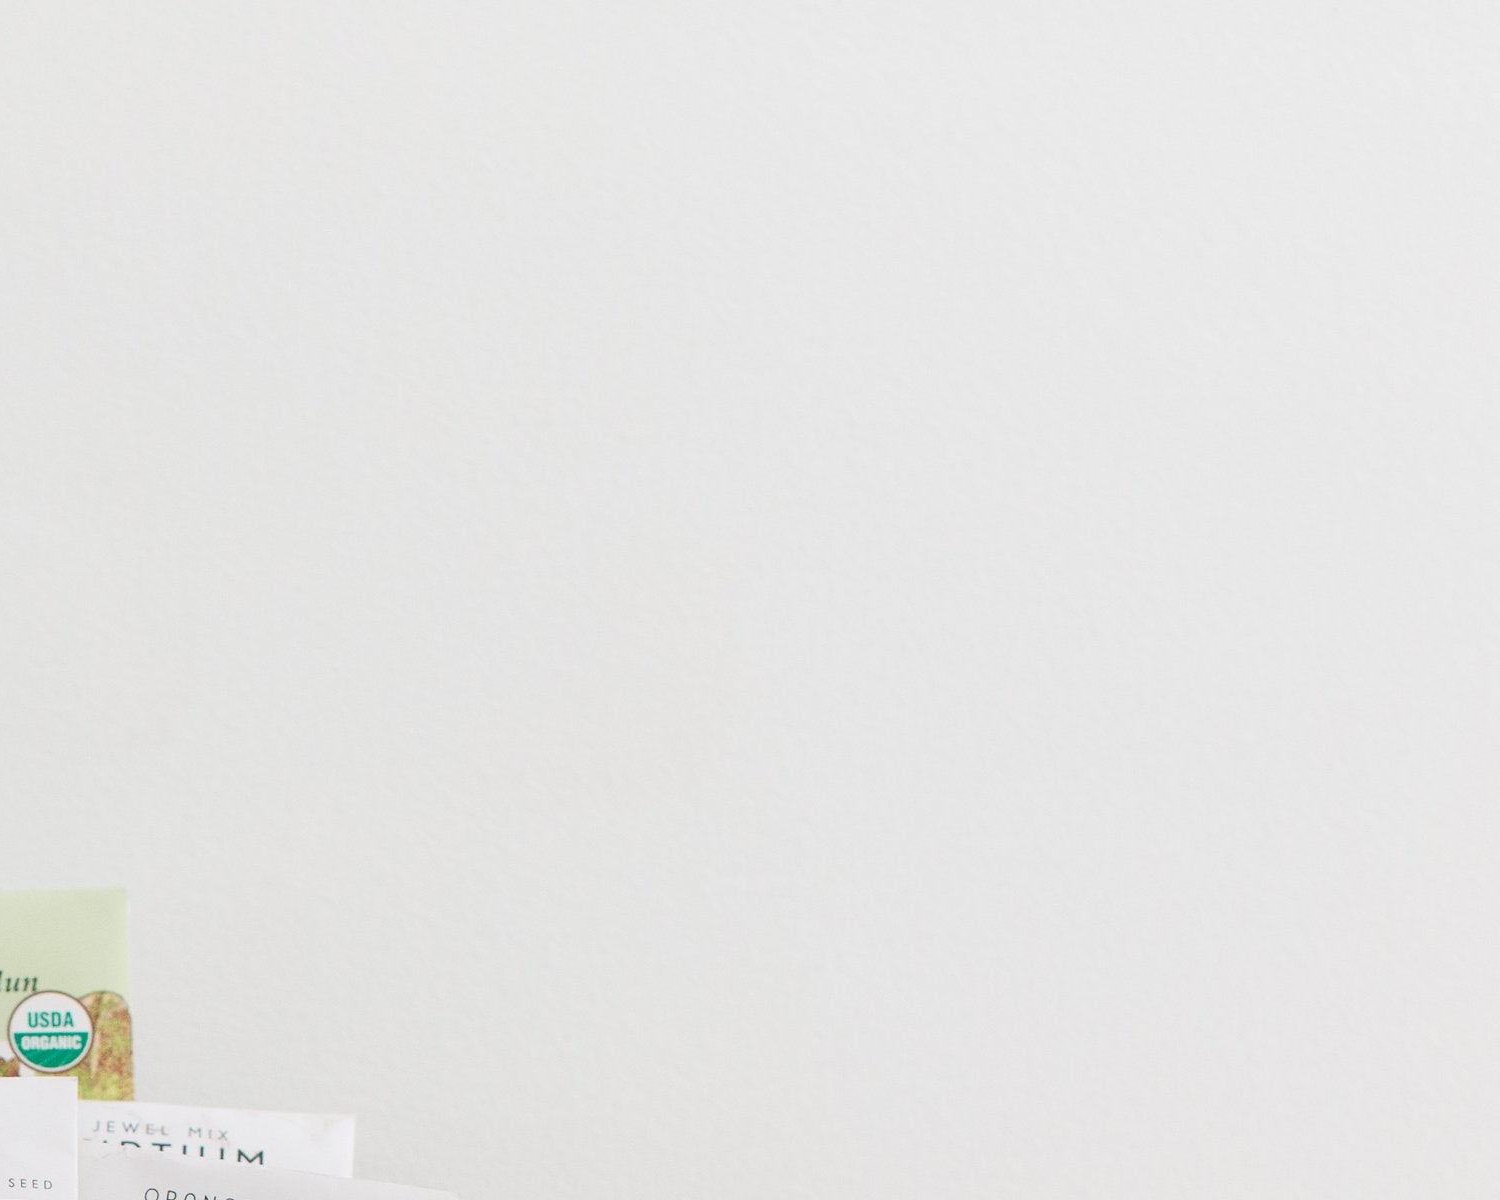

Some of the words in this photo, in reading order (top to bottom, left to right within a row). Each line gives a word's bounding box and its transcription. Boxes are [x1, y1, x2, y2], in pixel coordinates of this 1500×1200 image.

[28, 1011, 74, 1028] USDA
[21, 1034, 83, 1051] ORGANIC
[92, 1120, 169, 1136] JEWEL
[187, 1126, 229, 1141] MIX
[8, 1178, 53, 1190] SEED
